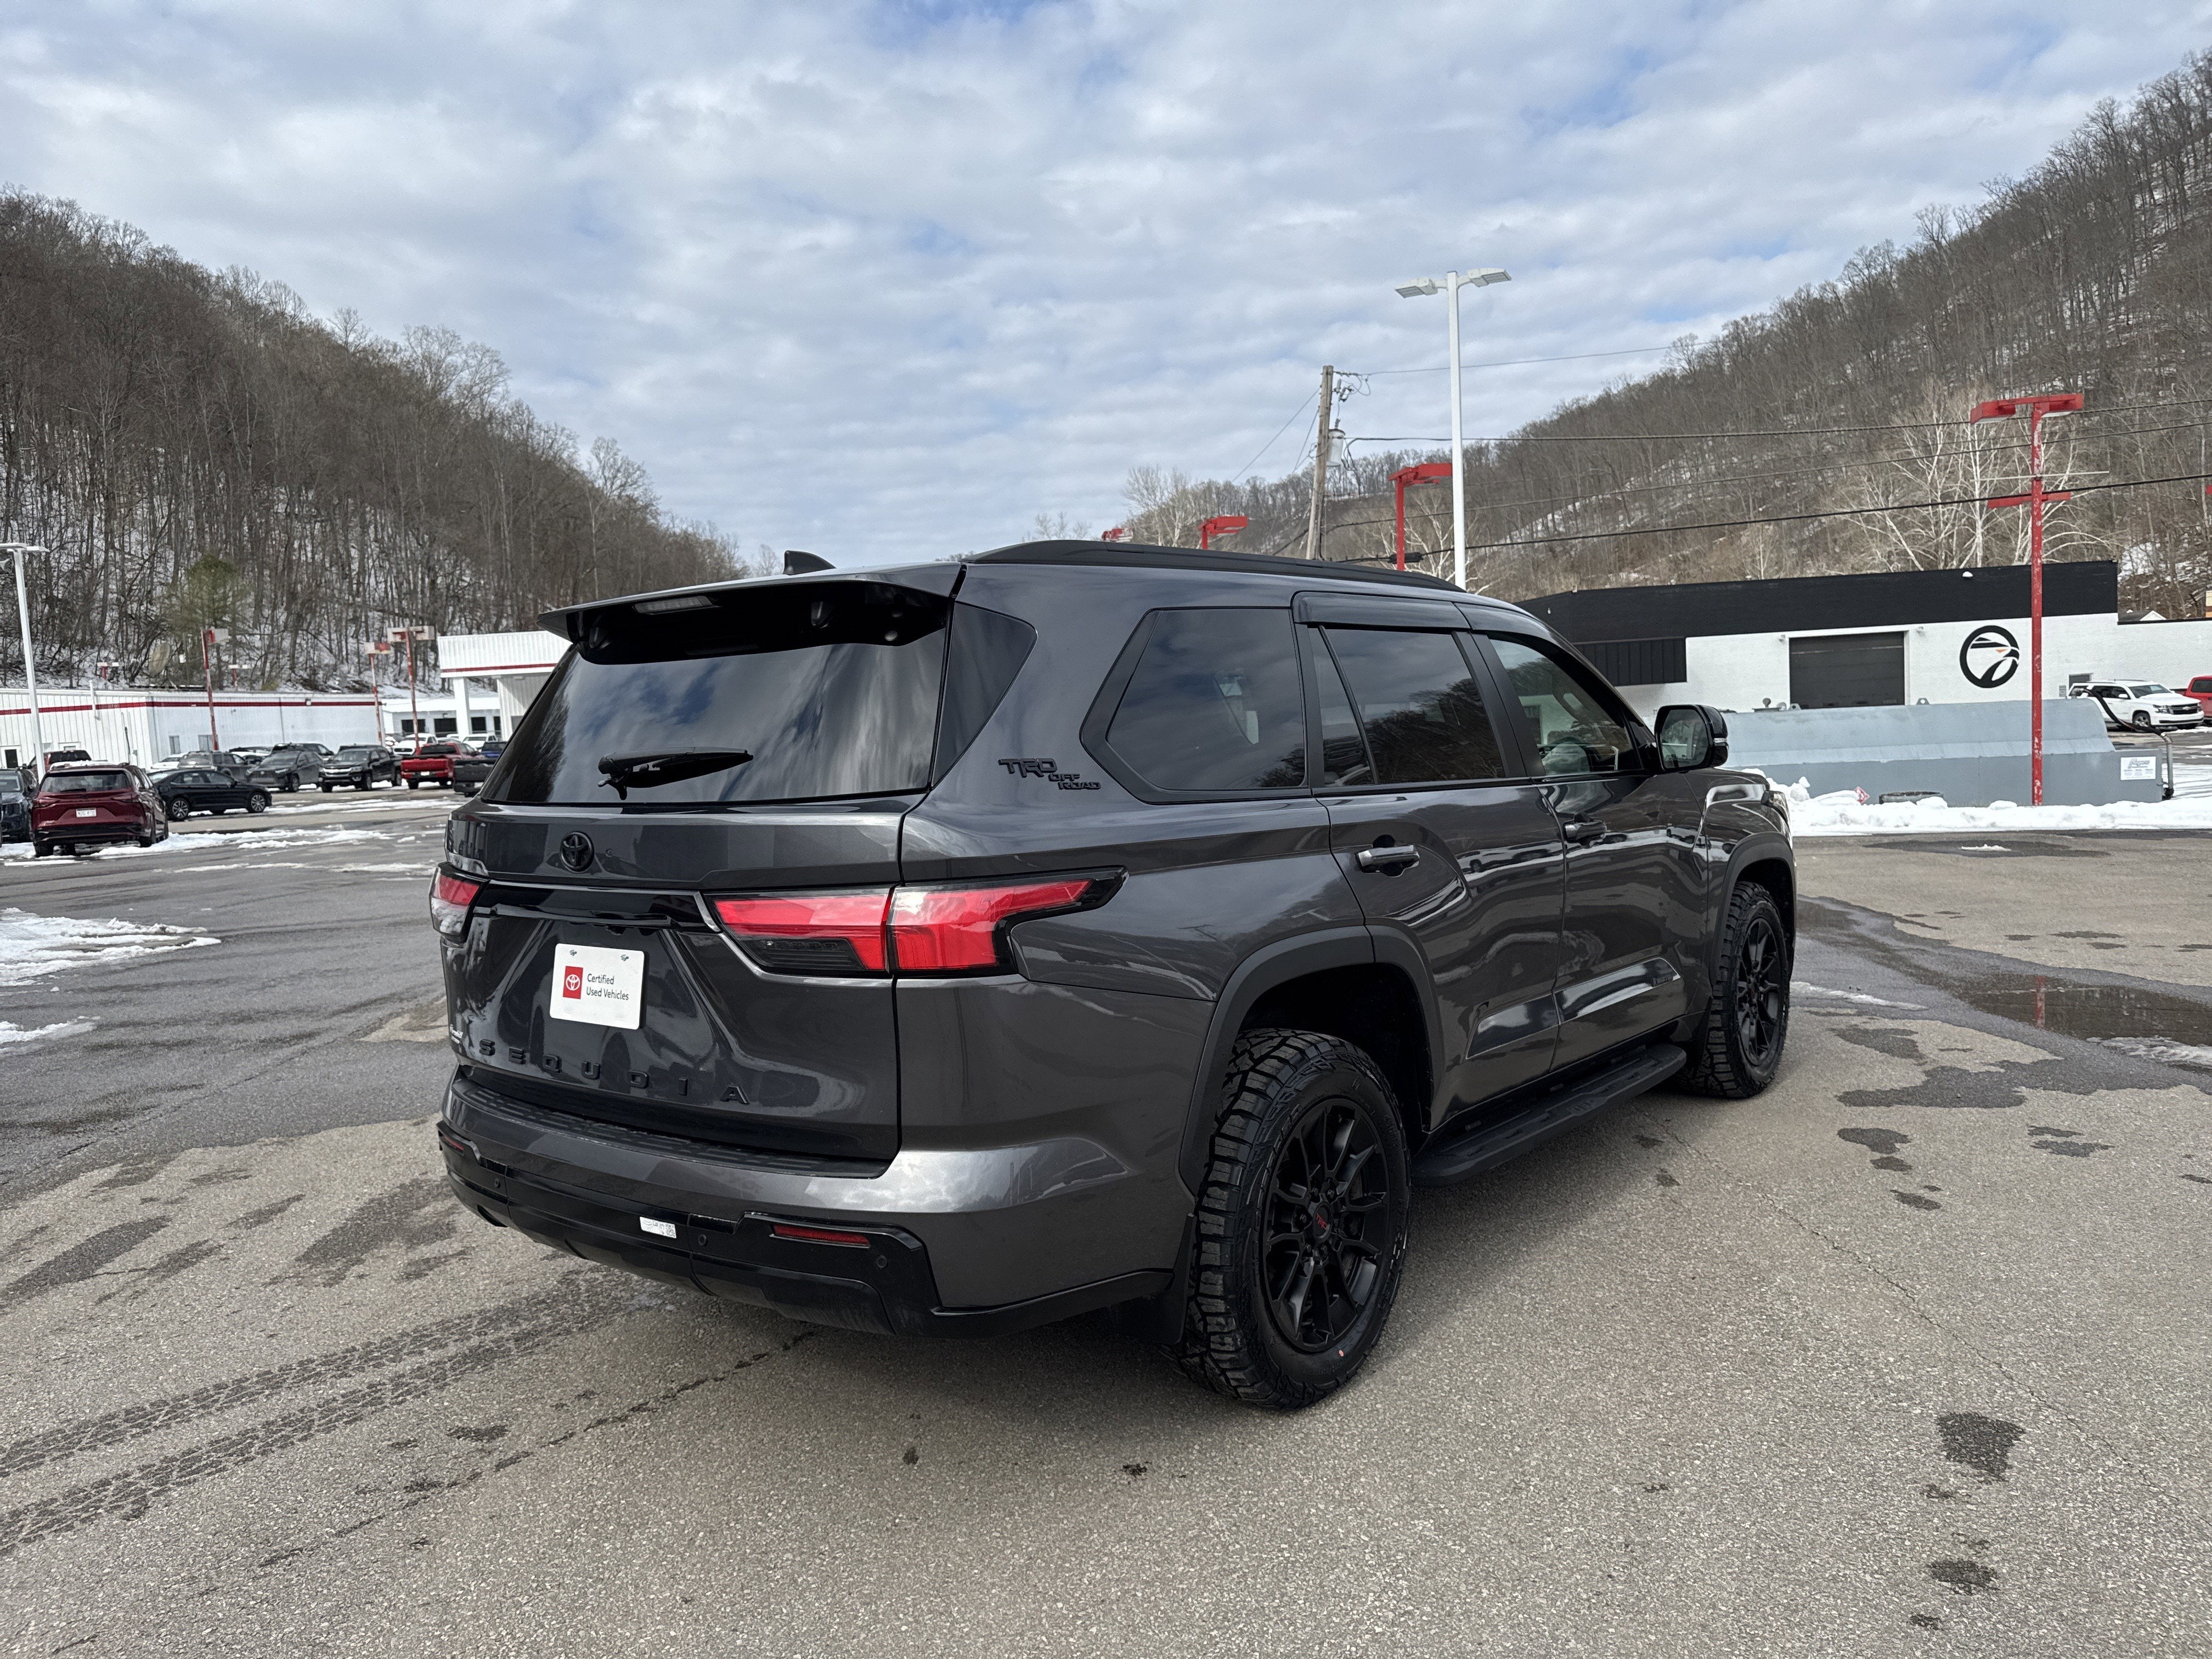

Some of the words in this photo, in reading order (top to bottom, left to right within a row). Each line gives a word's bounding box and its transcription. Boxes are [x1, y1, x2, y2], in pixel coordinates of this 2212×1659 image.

[998, 758, 1058, 778] TRD
[1048, 773, 1081, 782] OFF
[1057, 781, 1102, 790] ROAD
[587, 973, 614, 985] Certified
[586, 986, 602, 997] Used
[603, 988, 629, 1000] Vehicles
[479, 1039, 749, 1104] SEQUOIA
